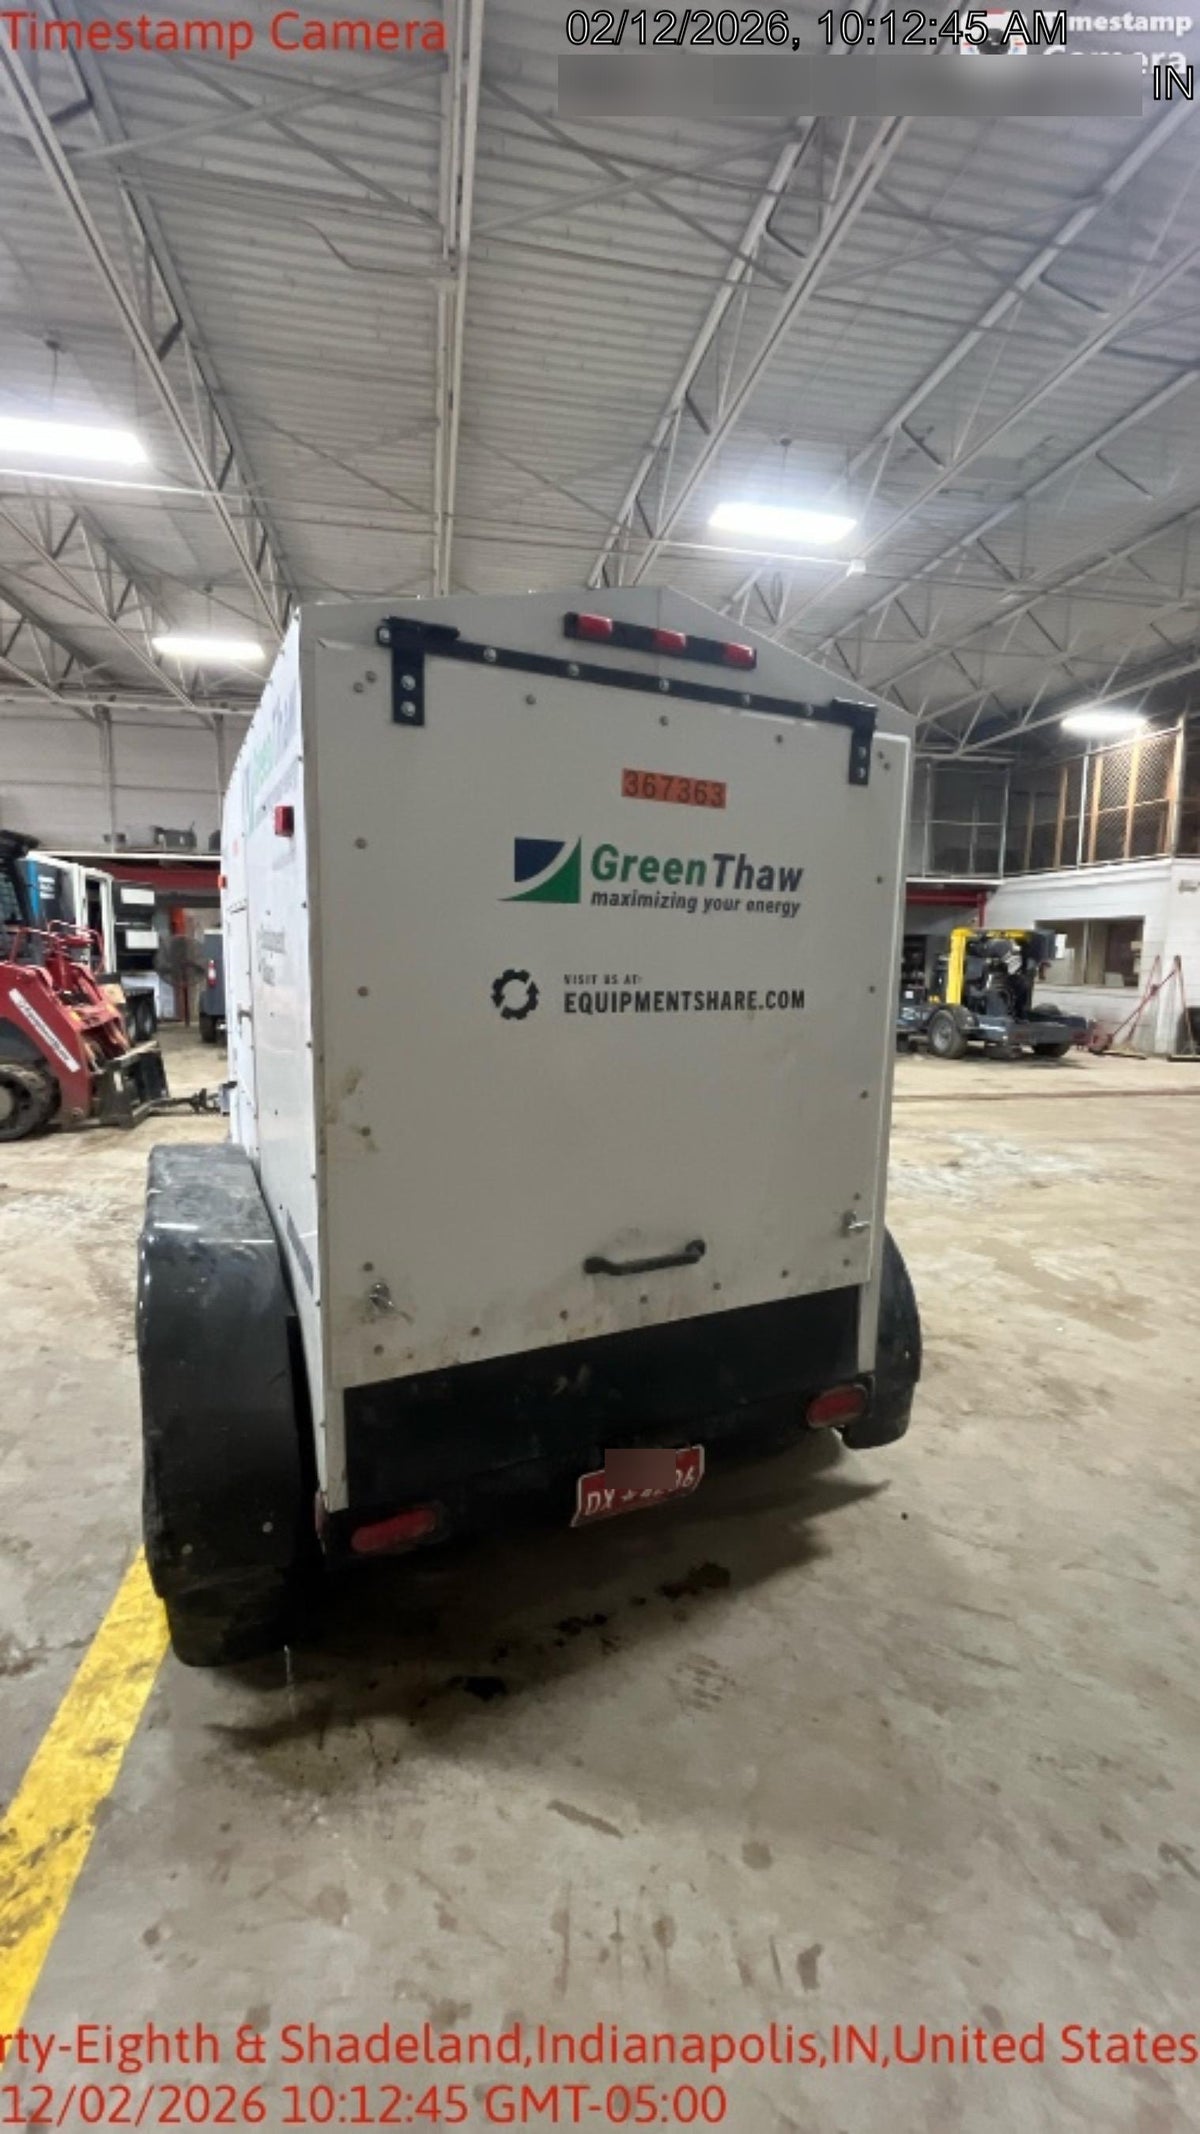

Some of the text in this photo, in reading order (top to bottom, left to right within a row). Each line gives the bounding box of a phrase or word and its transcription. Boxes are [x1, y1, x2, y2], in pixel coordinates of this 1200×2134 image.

[624, 770, 725, 807] 367363
[590, 888, 801, 918] maximizing your energy
[564, 974, 598, 986] VISIT
[602, 974, 619, 986] US
[563, 990, 805, 1014] EQUIPMENTSHARE.COM
